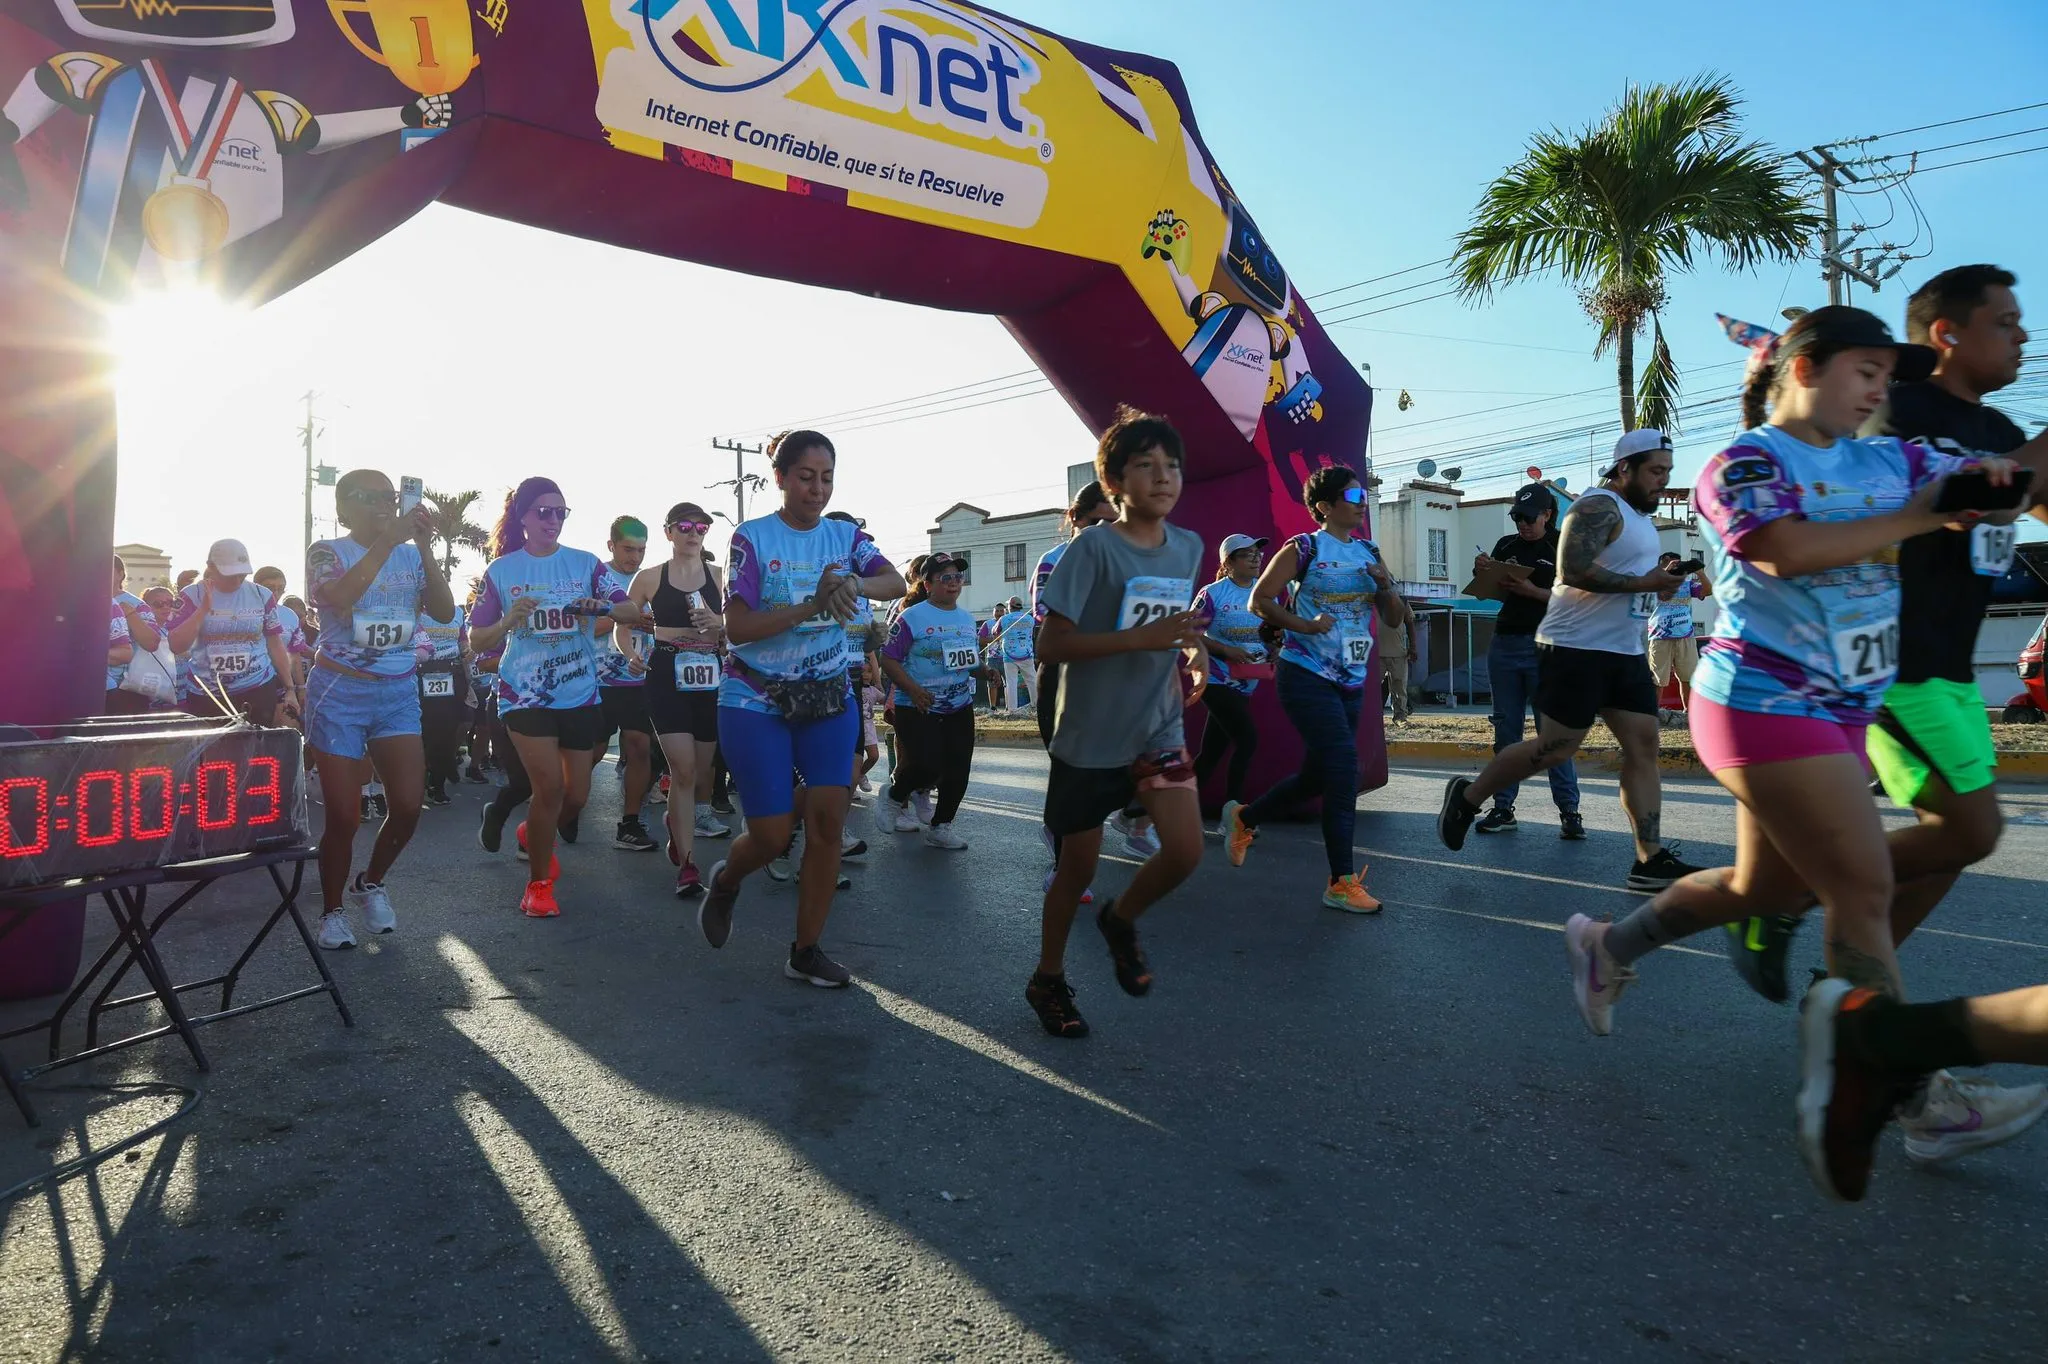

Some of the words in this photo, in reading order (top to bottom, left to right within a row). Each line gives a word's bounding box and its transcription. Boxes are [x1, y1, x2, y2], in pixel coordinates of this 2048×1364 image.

[410, 16, 439, 68] 1
[222, 144, 260, 161] net
[645, 98, 730, 138] Internet
[844, 156, 877, 175] que
[879, 162, 897, 181] sí
[899, 166, 915, 185] te
[917, 169, 1005, 207] Resuelve
[533, 608, 575, 630] 086
[365, 623, 403, 647] 131
[214, 655, 246, 672] 245
[802, 639, 844, 669] RESUELVE
[950, 649, 976, 667] 205
[683, 665, 714, 685] 087
[428, 681, 449, 694] 237
[0, 756, 281, 859] 0:00:03
